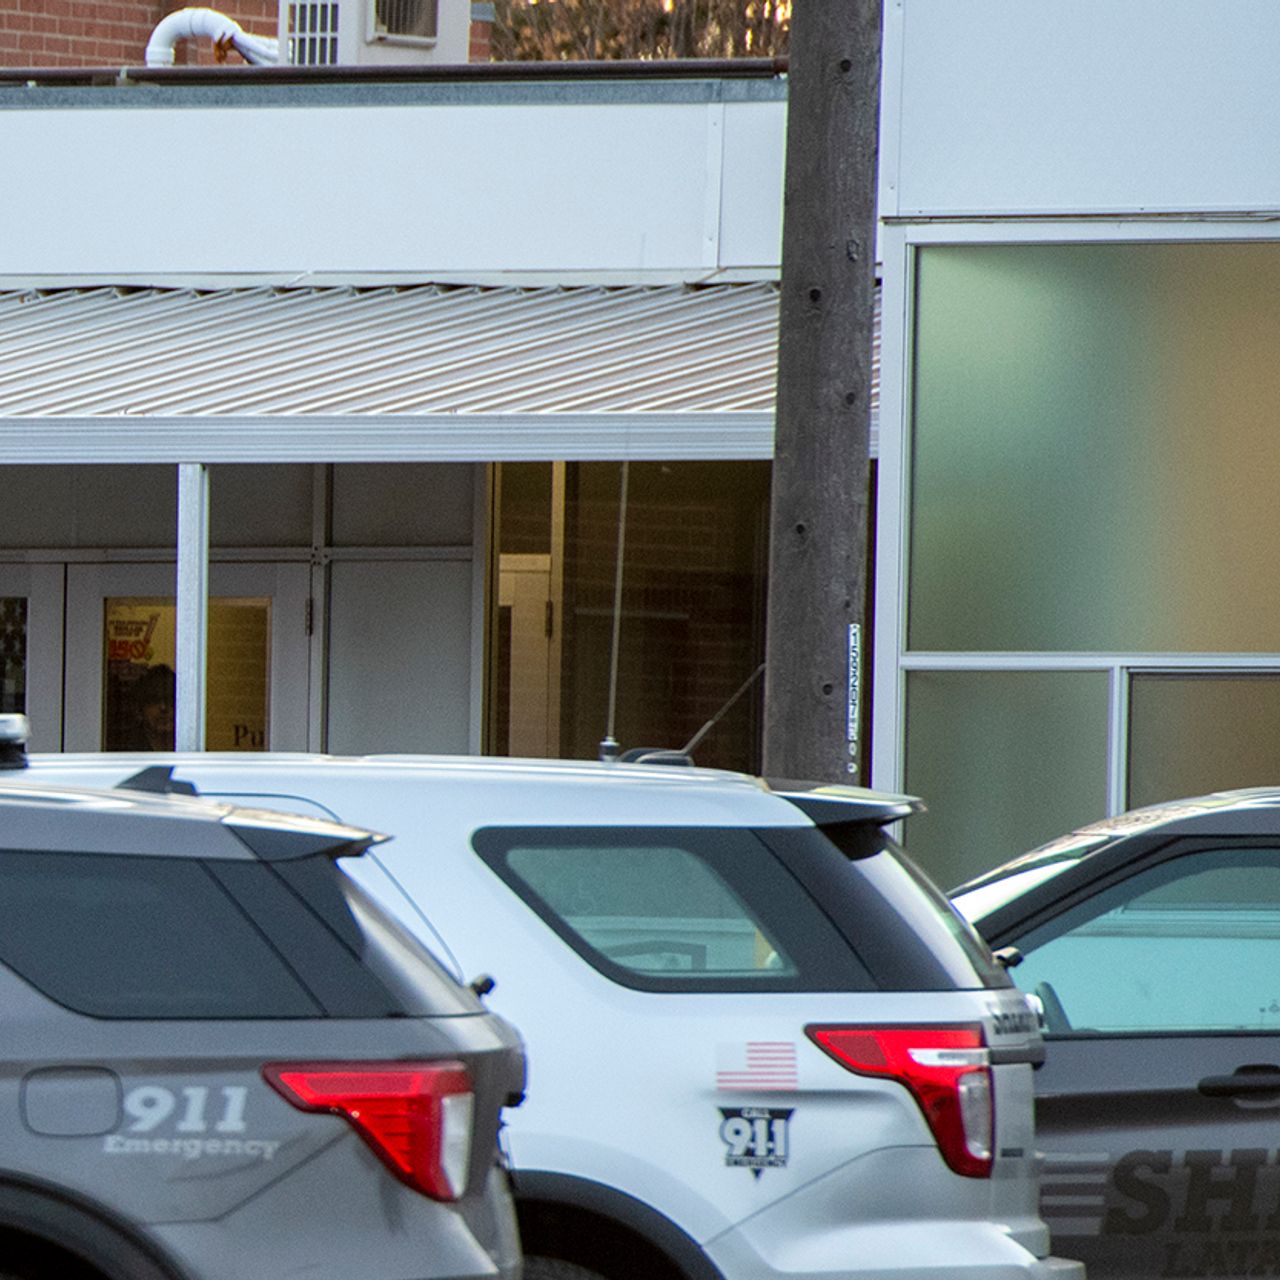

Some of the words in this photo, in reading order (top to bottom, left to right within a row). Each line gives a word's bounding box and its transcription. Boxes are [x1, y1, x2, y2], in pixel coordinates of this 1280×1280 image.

[124, 1086, 248, 1133] 911
[103, 1136, 280, 1160] Emergency
[1101, 1149, 1280, 1236] SH
